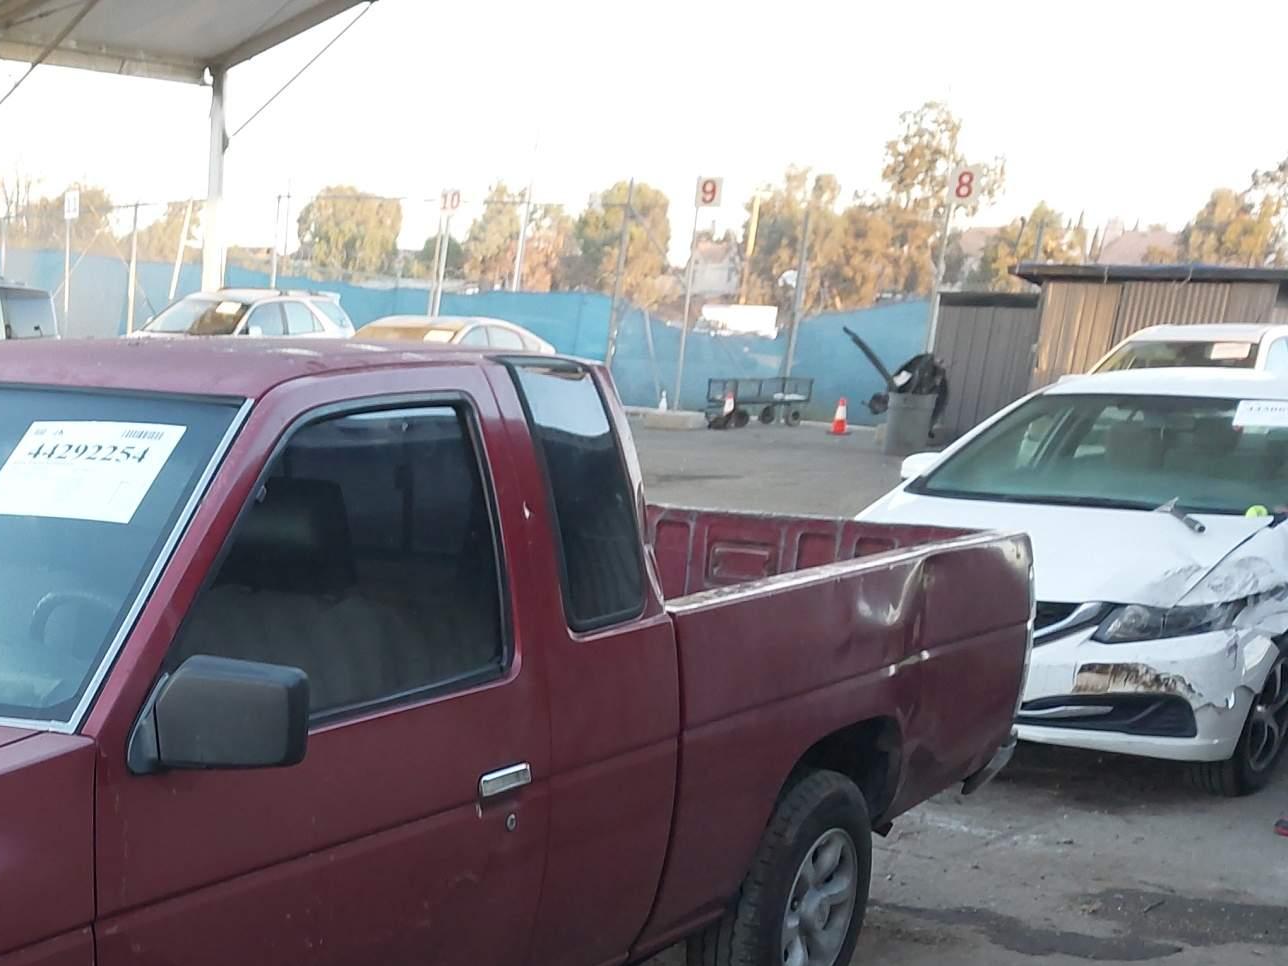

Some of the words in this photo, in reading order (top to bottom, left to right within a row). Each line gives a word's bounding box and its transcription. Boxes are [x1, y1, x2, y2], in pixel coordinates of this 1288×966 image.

[702, 179, 716, 204] 9
[956, 171, 974, 198] 8
[442, 190, 461, 210] 10
[27, 442, 151, 464] 44292254
